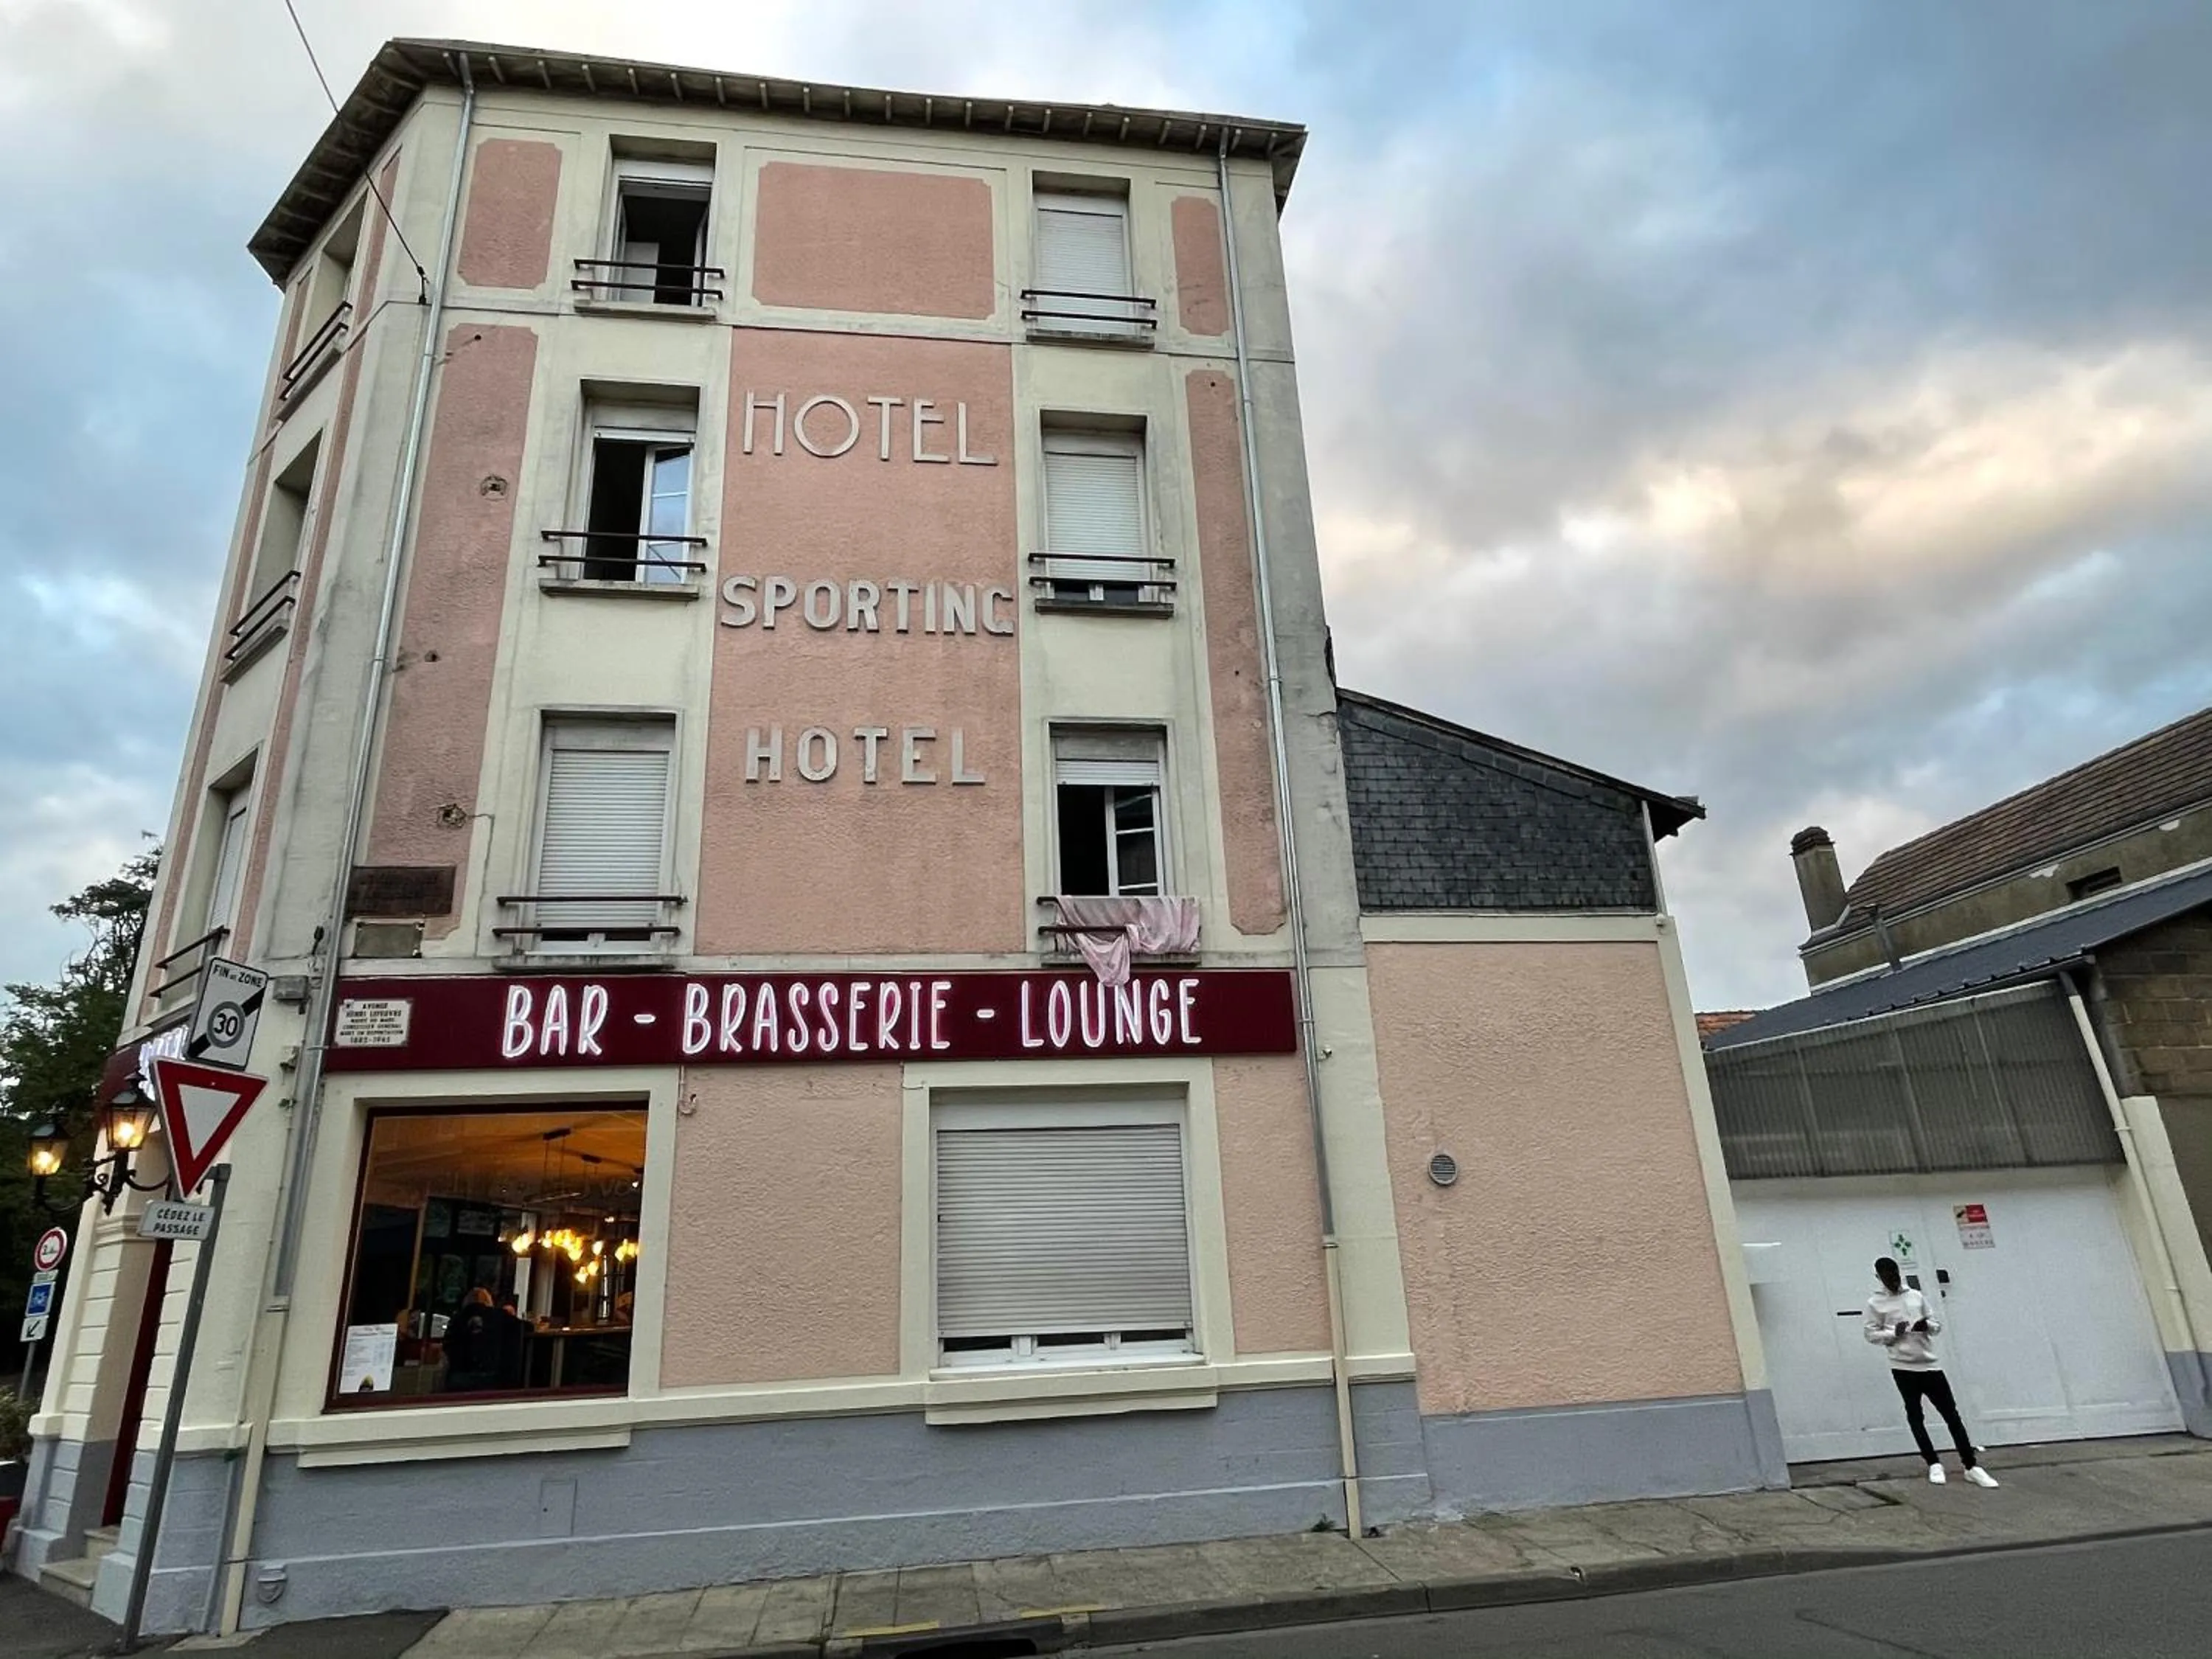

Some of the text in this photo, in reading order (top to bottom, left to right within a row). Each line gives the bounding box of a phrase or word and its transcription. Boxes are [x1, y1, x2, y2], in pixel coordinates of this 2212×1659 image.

[742, 389, 998, 466] HOTEL
[745, 725, 987, 786] HOTEL
[212, 963, 264, 988] FIN ZONE
[213, 1012, 238, 1037] 30
[502, 984, 609, 1058] BAR
[681, 981, 953, 1054] BRASSERIE
[1020, 978, 1203, 1048] LOUNGE
[153, 1222, 200, 1236] PASSAGE
[192, 1211, 206, 1222] LE
